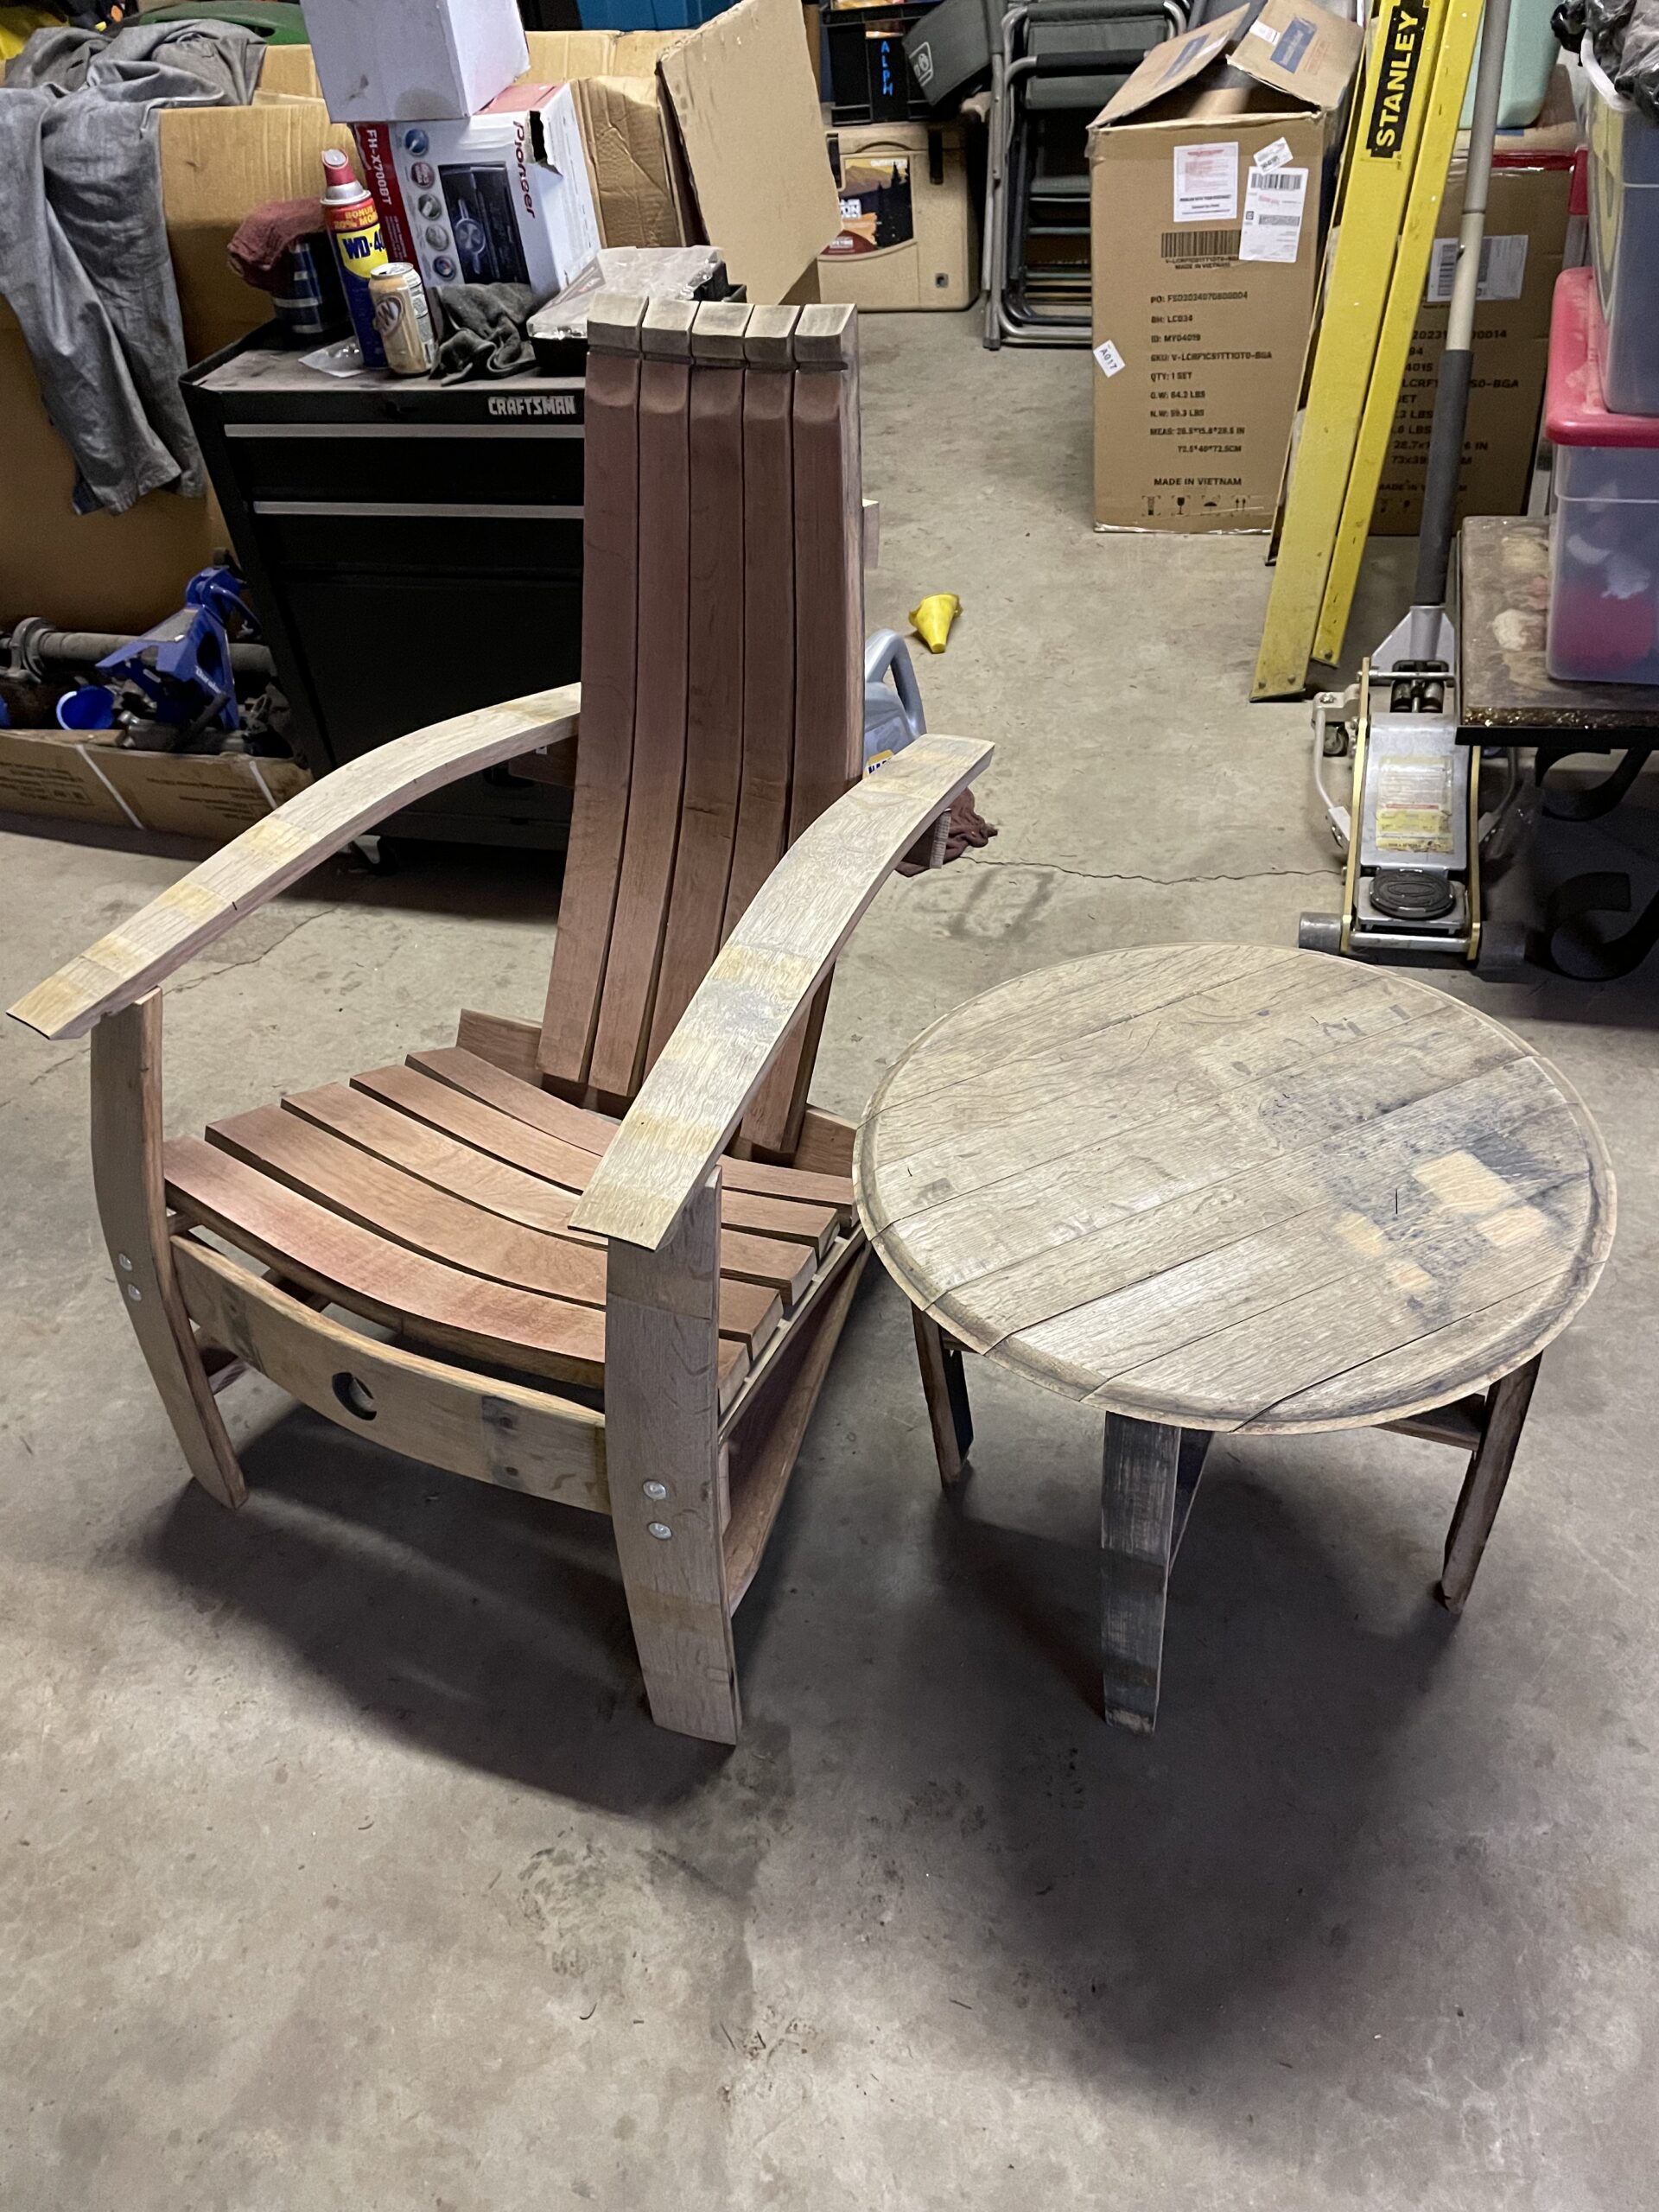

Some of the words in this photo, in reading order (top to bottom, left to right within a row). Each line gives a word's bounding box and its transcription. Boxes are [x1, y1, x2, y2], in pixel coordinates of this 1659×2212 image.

[1376, 10, 1419, 147] STANLEY
[366, 129, 392, 206] FH-X700BT
[342, 230, 386, 260] WD-4
[1099, 347, 1118, 369] A017
[1150, 372, 1170, 382] QTY:
[487, 395, 577, 416] CRAFTSMAN
[1154, 477, 1182, 486] MADE
[1197, 477, 1243, 486] VIETNAM
